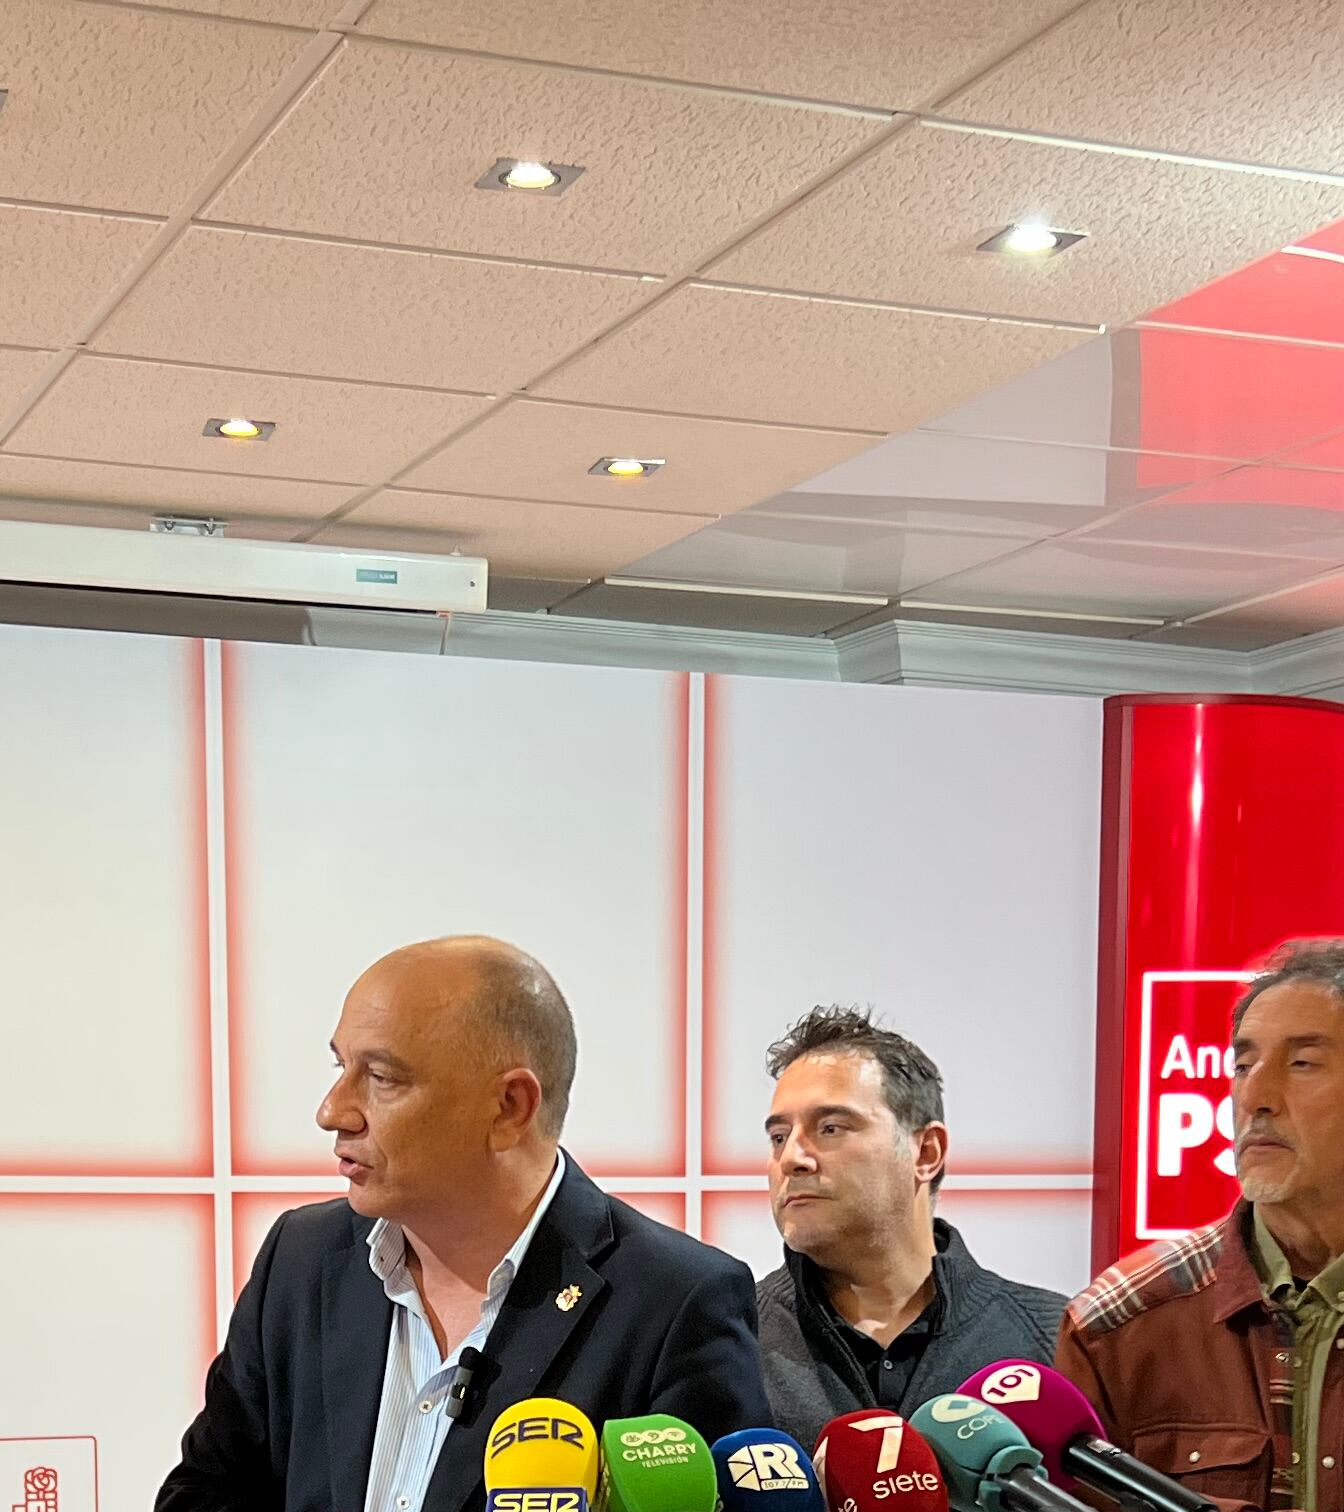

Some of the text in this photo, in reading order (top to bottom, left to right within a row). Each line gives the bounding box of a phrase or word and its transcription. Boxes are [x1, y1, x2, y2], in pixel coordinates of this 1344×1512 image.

[986, 1368, 1035, 1398] 101
[491, 1416, 585, 1460] SER
[622, 1442, 697, 1462] CHARRY
[872, 1470, 940, 1500] siete
